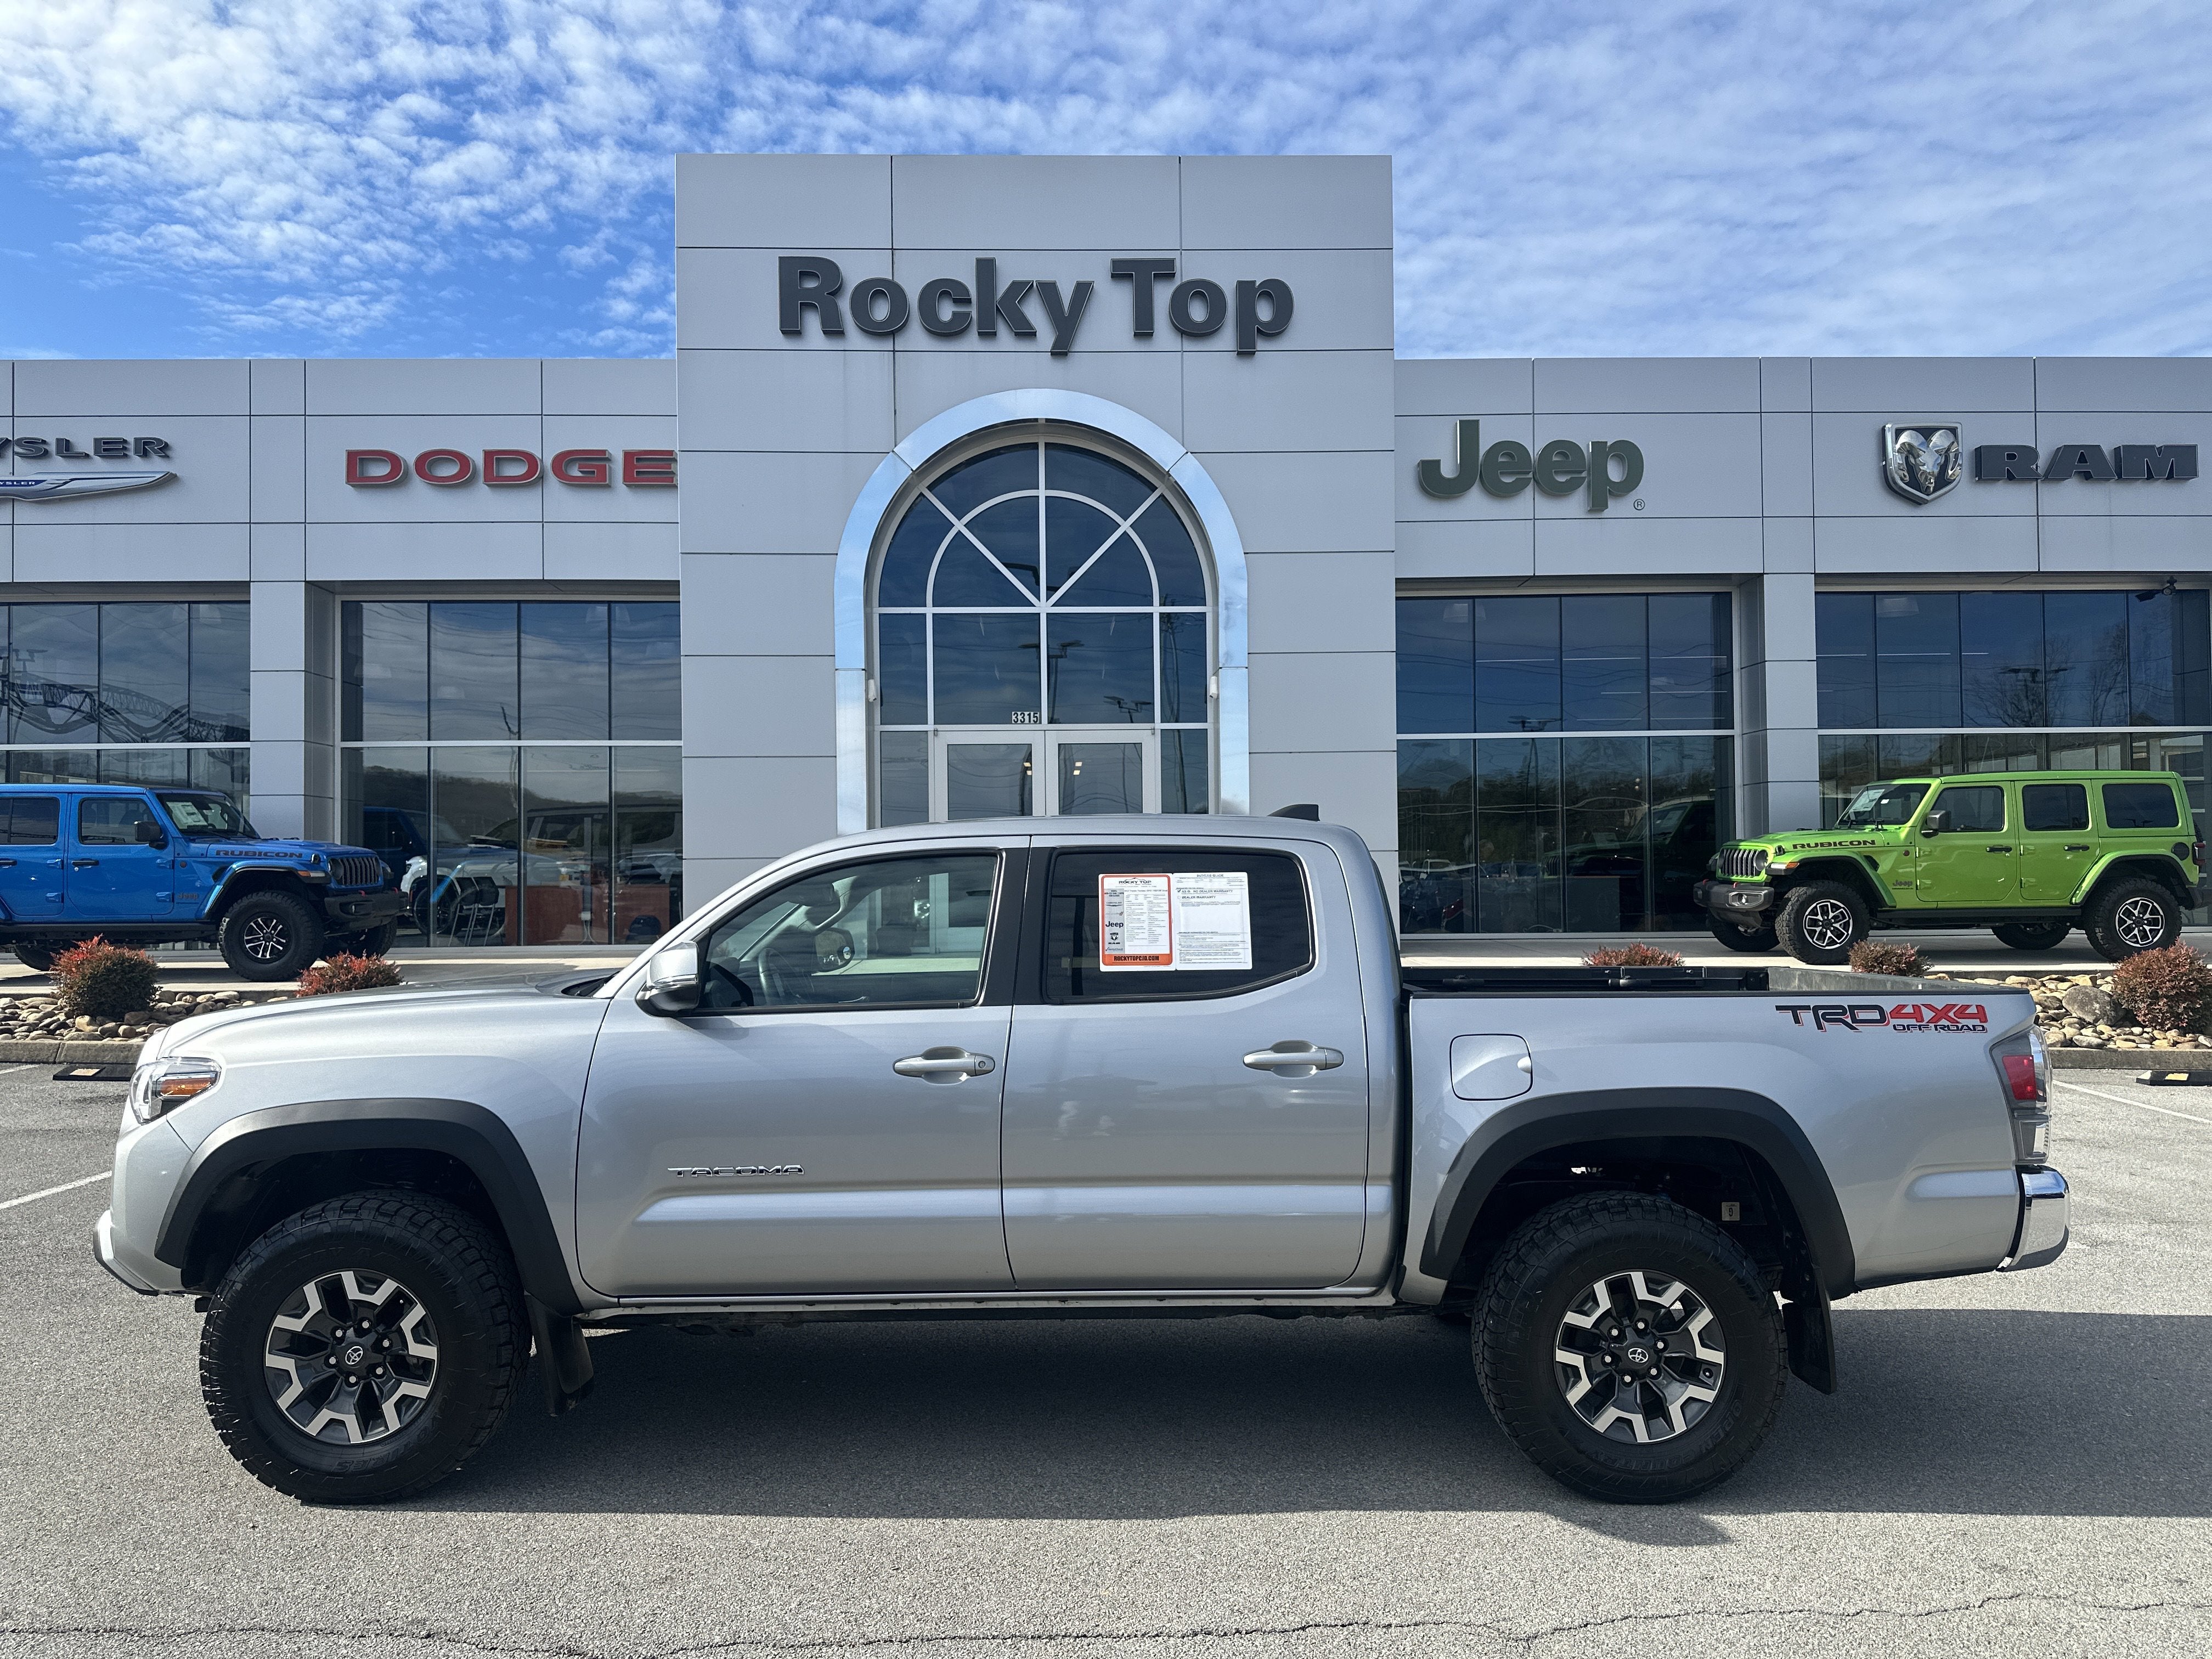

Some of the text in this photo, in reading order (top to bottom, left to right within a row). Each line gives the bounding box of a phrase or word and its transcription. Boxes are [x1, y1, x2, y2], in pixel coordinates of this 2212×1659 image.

[778, 256, 1295, 356] Rocky Top
[346, 449, 678, 487] DODGE
[1417, 419, 1644, 512] Jeep
[1975, 444, 2199, 481] RAM
[1013, 712, 1039, 723] 3315
[216, 850, 303, 858] RUBICON
[1792, 840, 1876, 849] RUBICON
[1775, 1005, 1891, 1032] TRD
[1892, 1024, 1988, 1033] OFF ROAD
[668, 1165, 805, 1178] TACOMA
